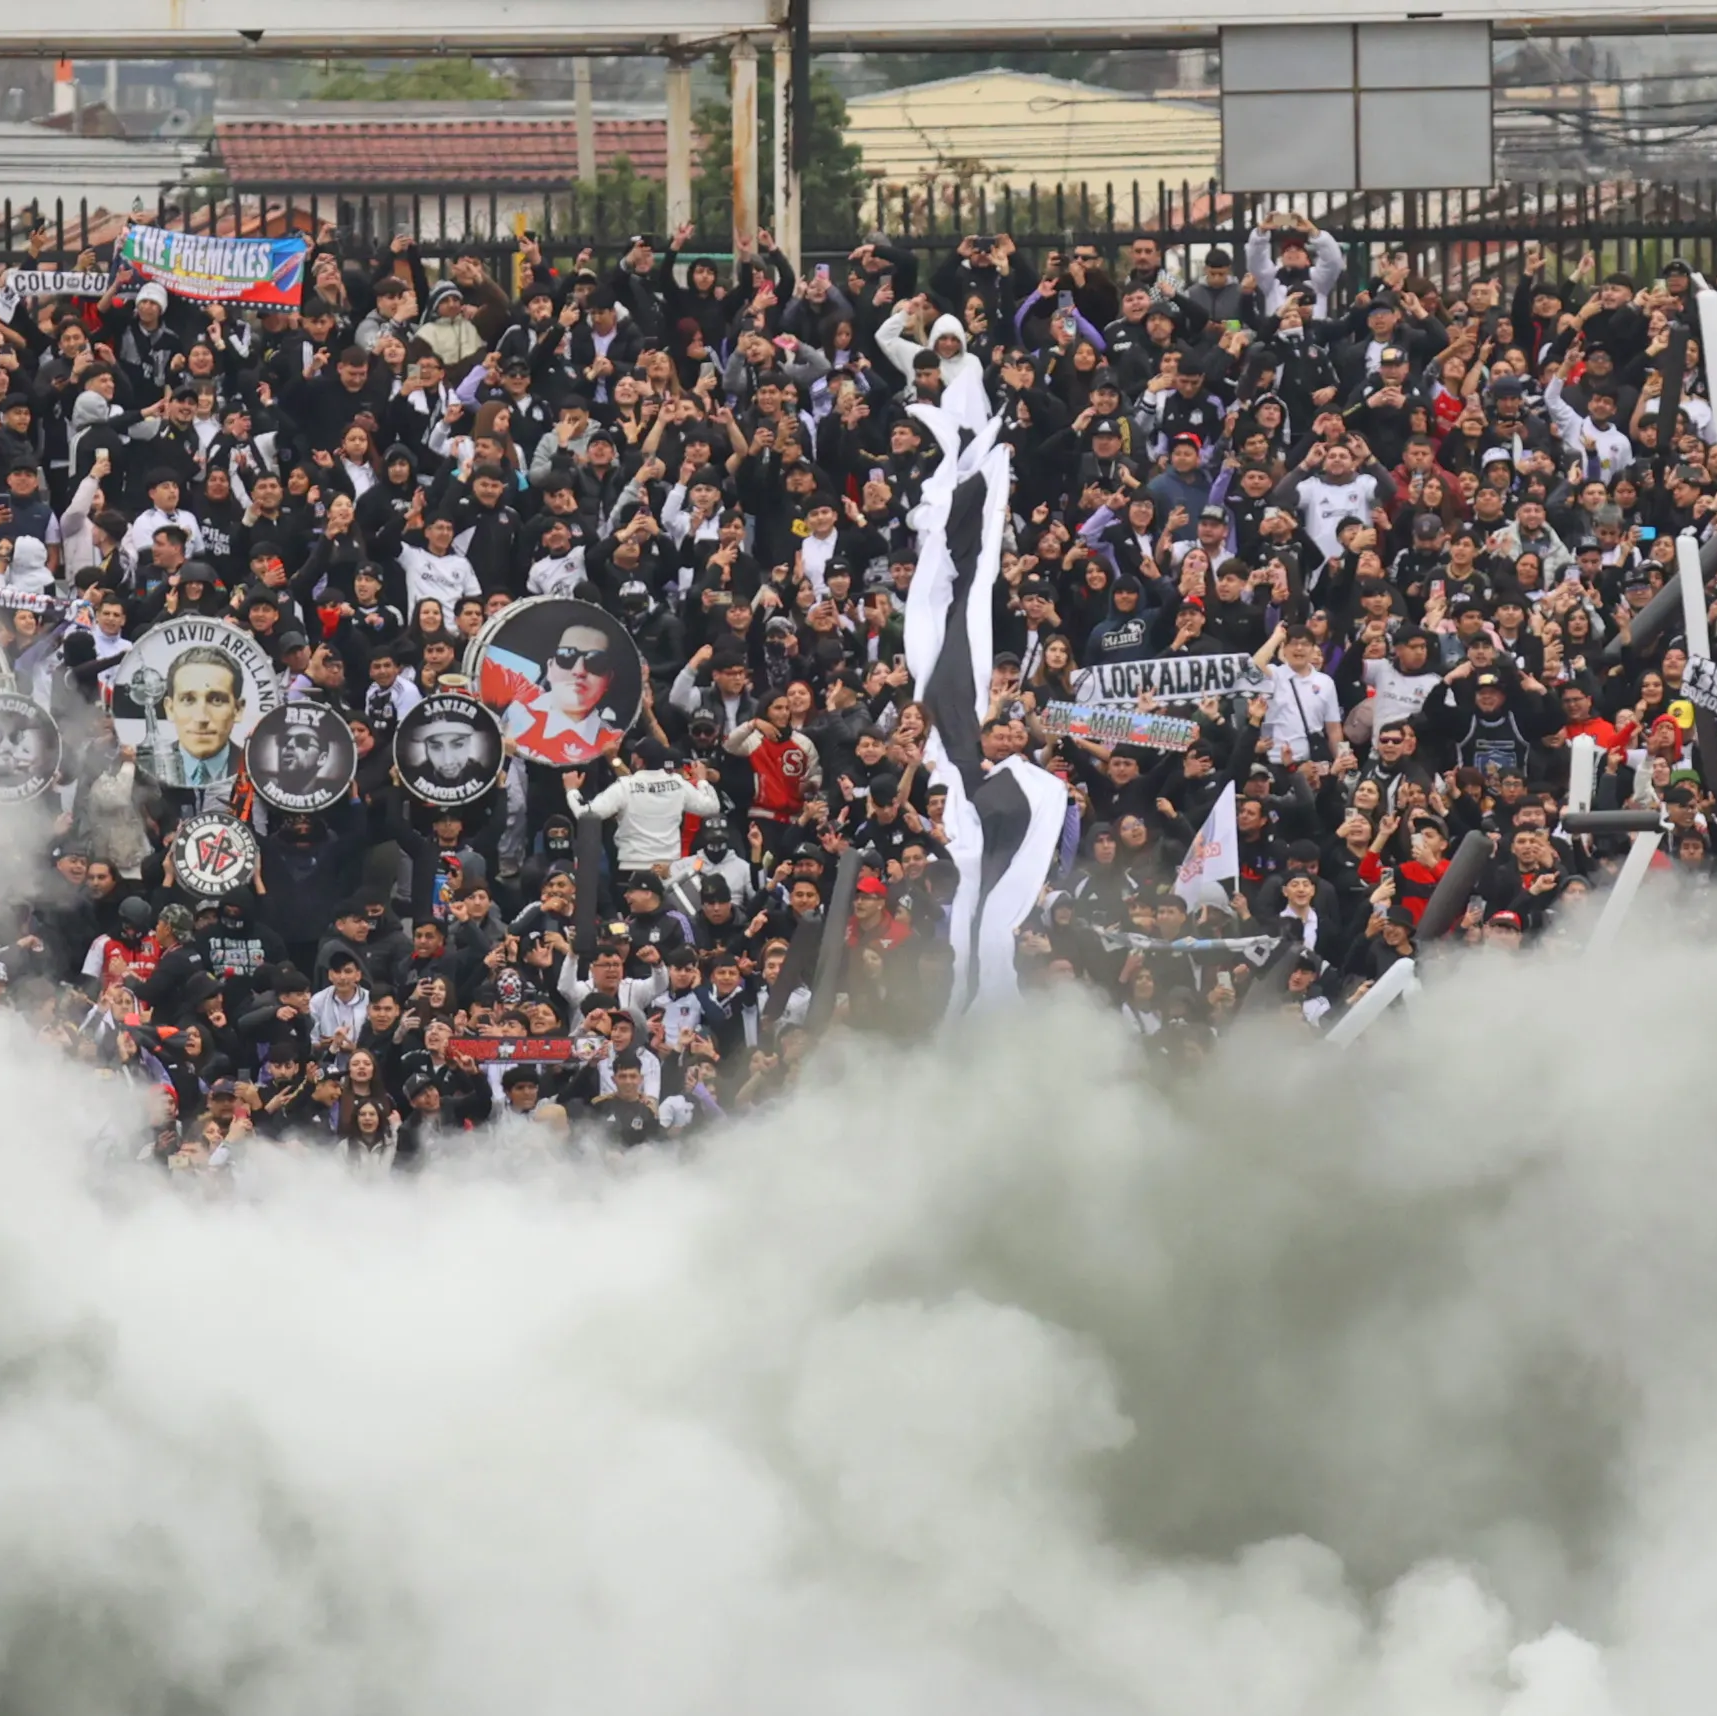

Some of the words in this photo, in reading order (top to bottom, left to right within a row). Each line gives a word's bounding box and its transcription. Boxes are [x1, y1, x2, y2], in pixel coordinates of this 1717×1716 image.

[134, 225, 165, 266] THE
[169, 232, 271, 278] PREMEKES
[15, 271, 64, 292] COLO
[164, 626, 215, 646] DAVID
[220, 633, 274, 713] ARELLANO
[1097, 654, 1234, 699] LOCKALBAS
[285, 706, 326, 727] REY
[424, 699, 479, 719] JAVIER
[782, 748, 808, 776] S
